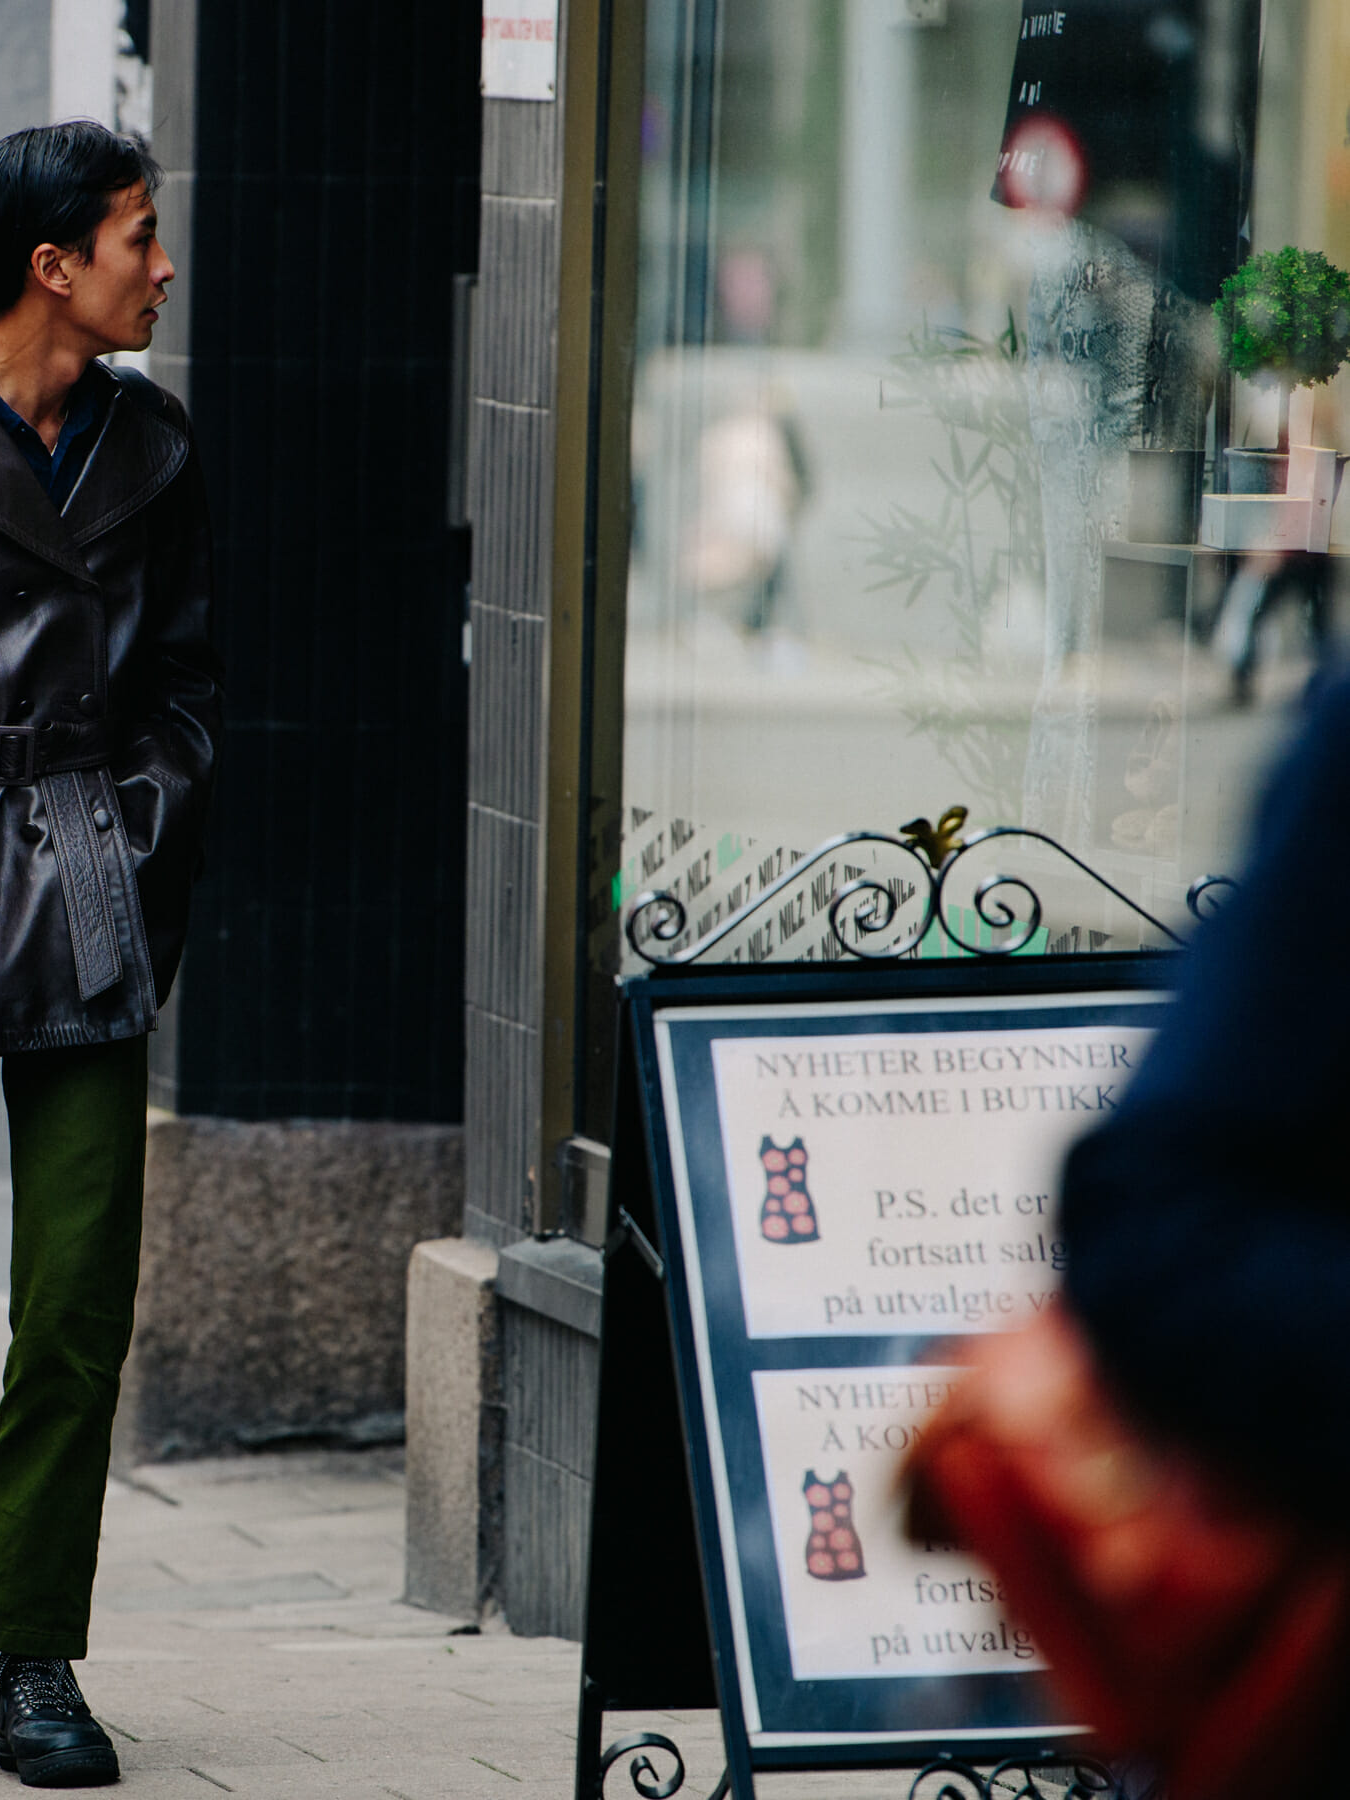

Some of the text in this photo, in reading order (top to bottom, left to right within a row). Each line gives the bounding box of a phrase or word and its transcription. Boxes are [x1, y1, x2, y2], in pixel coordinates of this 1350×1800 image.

[755, 1043, 1132, 1078] NYHETER BEGYNNER
[778, 1086, 801, 1118] Å
[812, 1088, 950, 1118] KOMME
[961, 1087, 971, 1113] I
[875, 1187, 1049, 1219] P.S. det er
[868, 1237, 987, 1267] fortsatt
[824, 1285, 863, 1324] på
[876, 1284, 1014, 1323] utvalgte
[822, 1420, 845, 1451] Å
[871, 1623, 911, 1665] på
